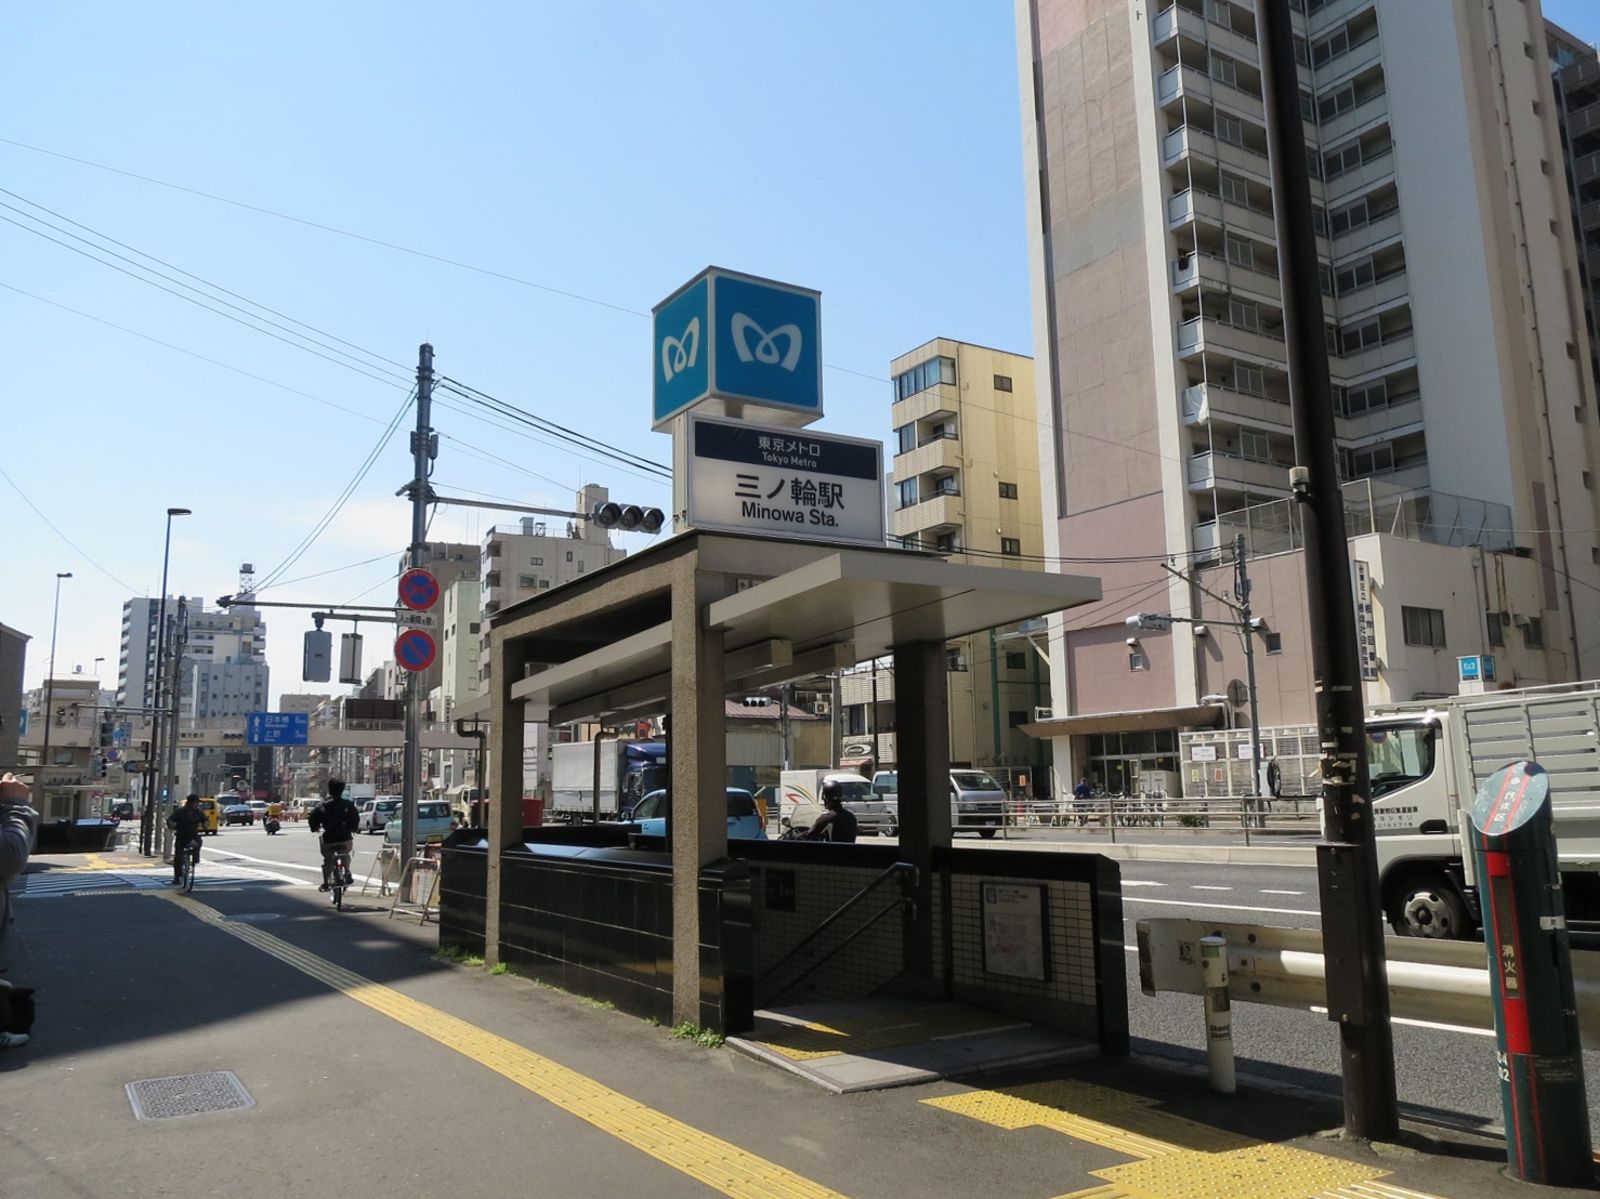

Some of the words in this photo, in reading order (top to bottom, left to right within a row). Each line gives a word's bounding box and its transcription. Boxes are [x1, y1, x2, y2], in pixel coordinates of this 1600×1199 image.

[758, 436, 820, 457] 東京メトロ
[762, 452, 789, 465] Tokyo
[790, 456, 817, 468] Metro
[735, 474, 845, 509] 三ノ輪駅
[742, 501, 804, 523] Minowa
[809, 509, 839, 527] Sta.
[1502, 944, 1518, 989] 消火器
